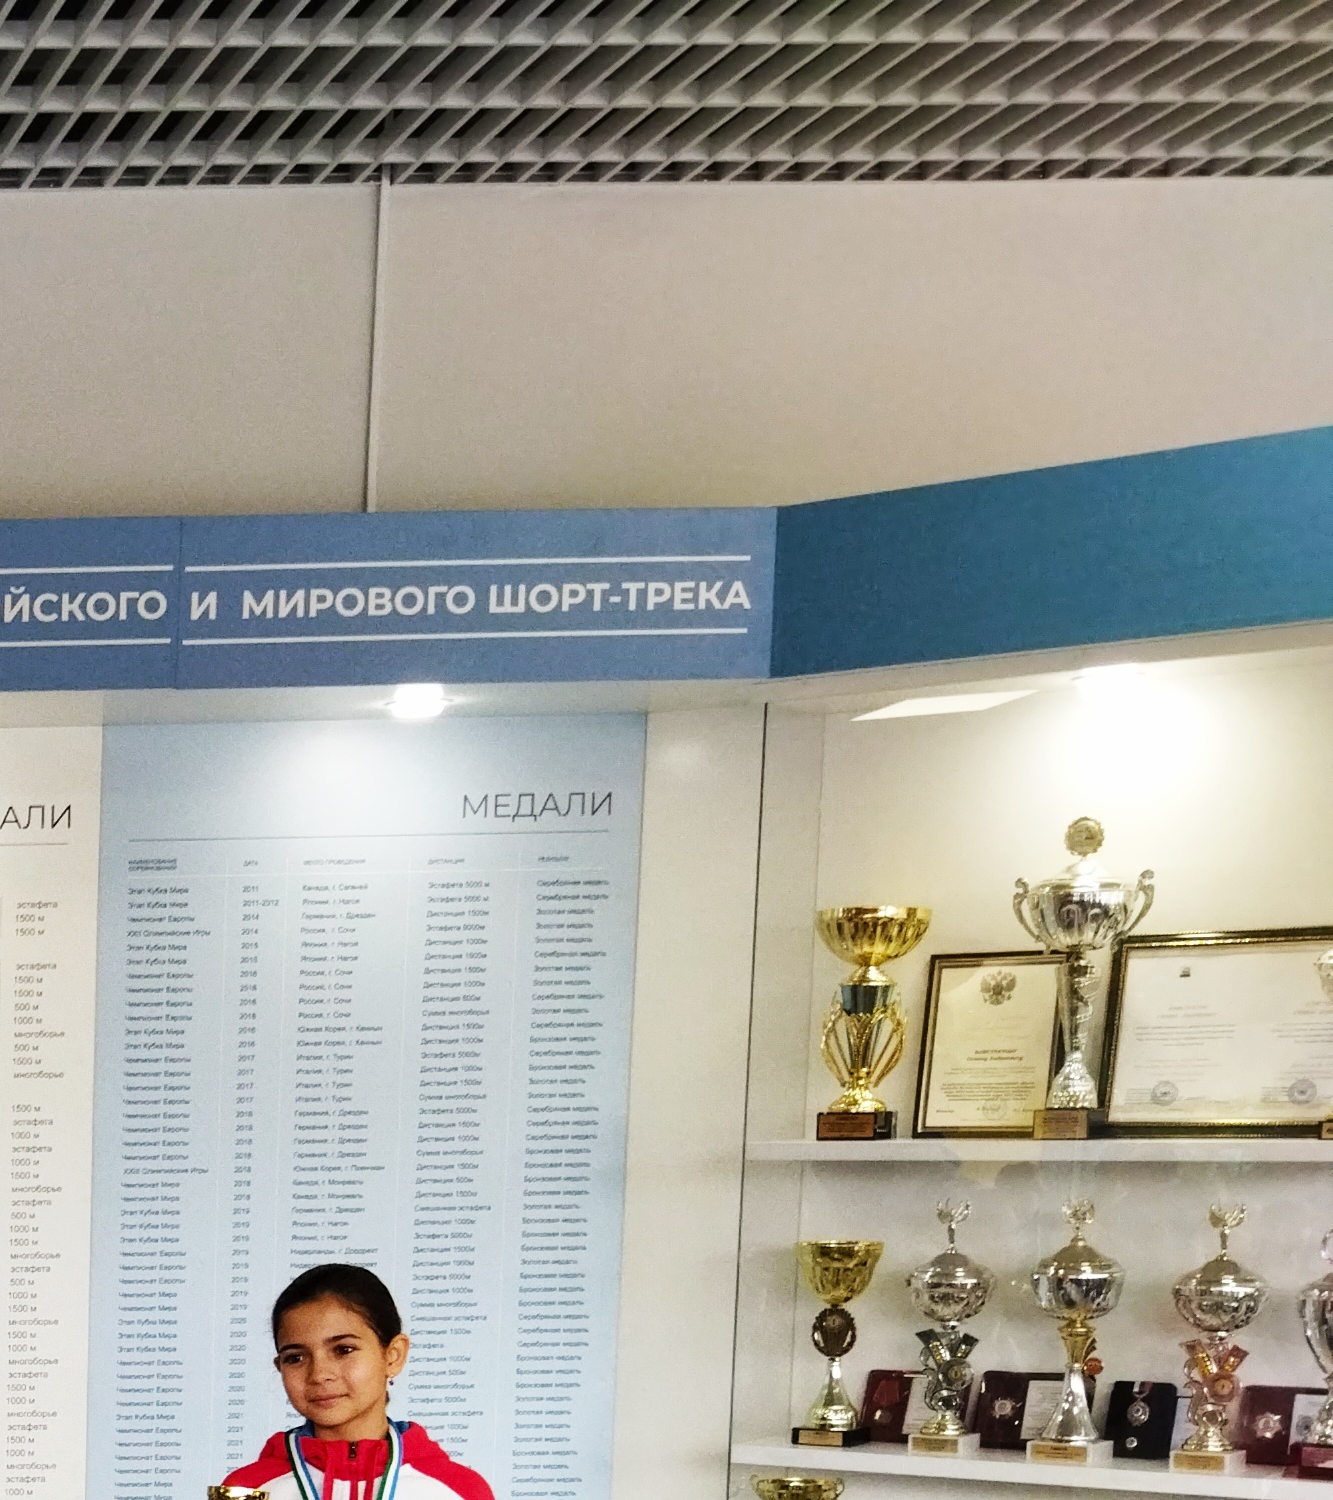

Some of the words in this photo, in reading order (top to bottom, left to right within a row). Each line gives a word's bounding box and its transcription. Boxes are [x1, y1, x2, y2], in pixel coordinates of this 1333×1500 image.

[191, 591, 217, 620] И
[242, 584, 475, 620] МИРОВОГО
[489, 579, 751, 616] ШОРТ-ТРЕКА
[462, 791, 613, 823] МЕДАЛИ
